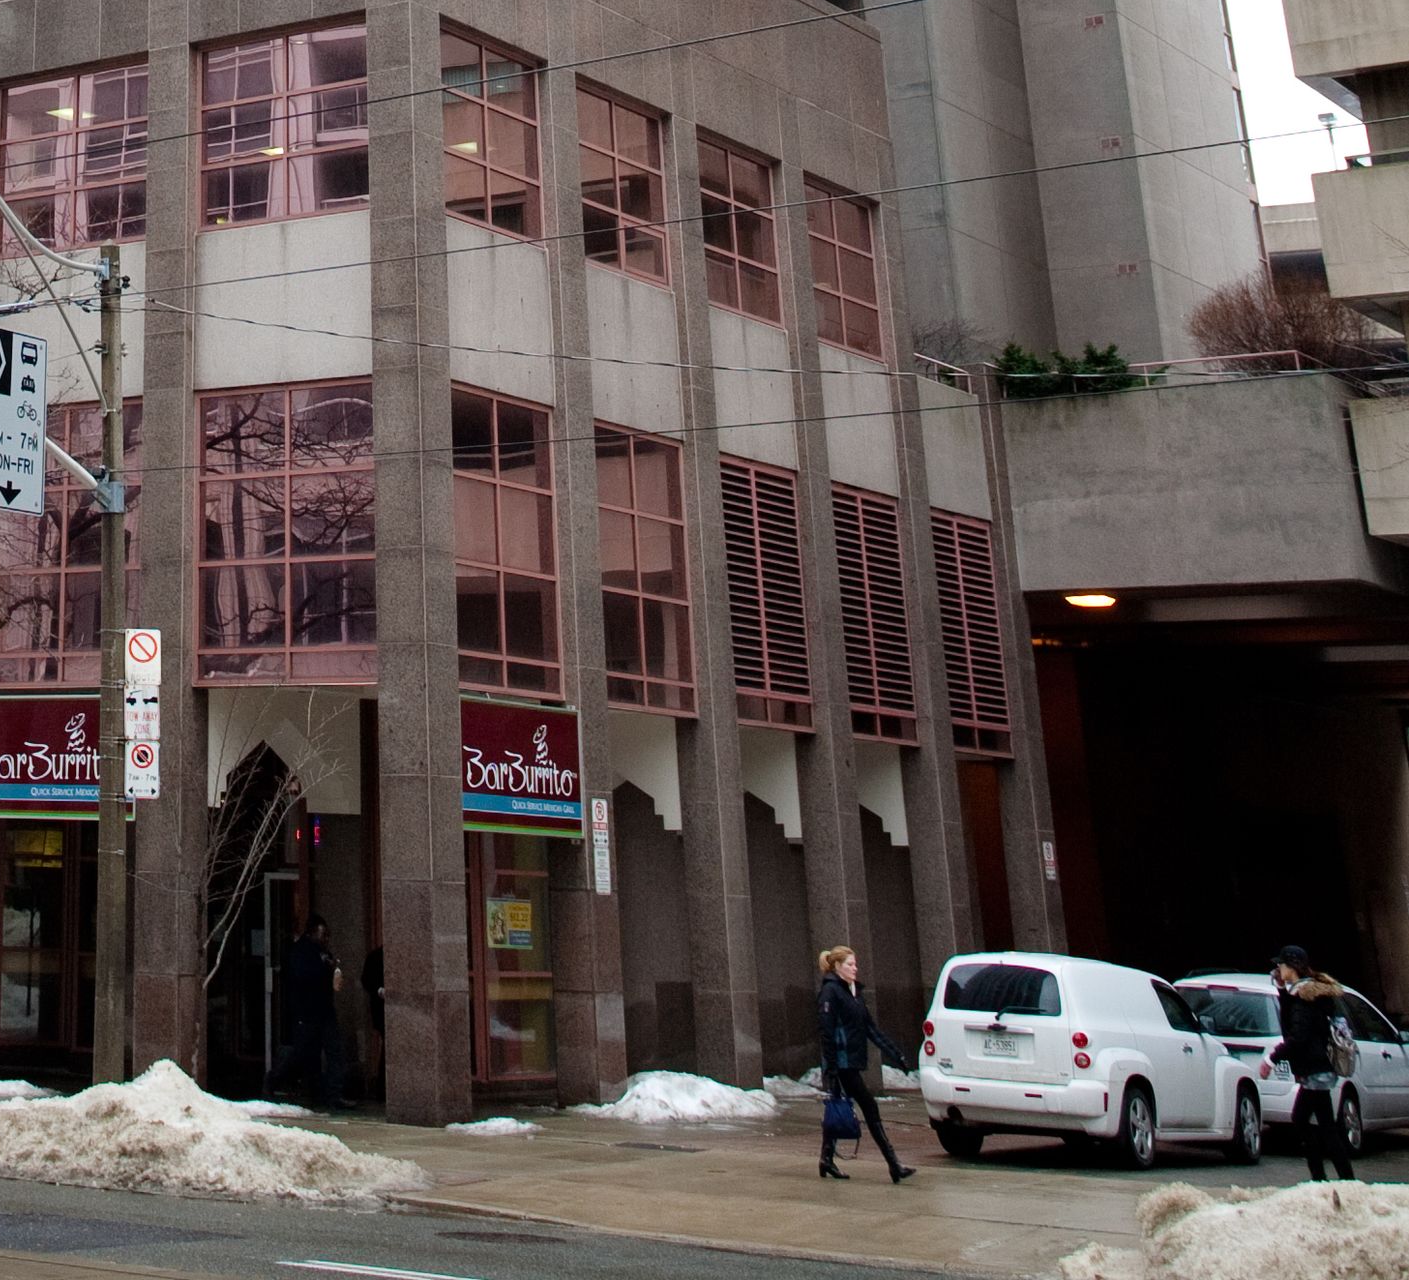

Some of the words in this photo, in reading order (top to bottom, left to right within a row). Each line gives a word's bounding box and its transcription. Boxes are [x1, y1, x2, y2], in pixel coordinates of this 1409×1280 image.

[20, 432, 39, 452] 7PM
[462, 744, 573, 797] BarBurrito
[75, 787, 100, 798] MEXICA
